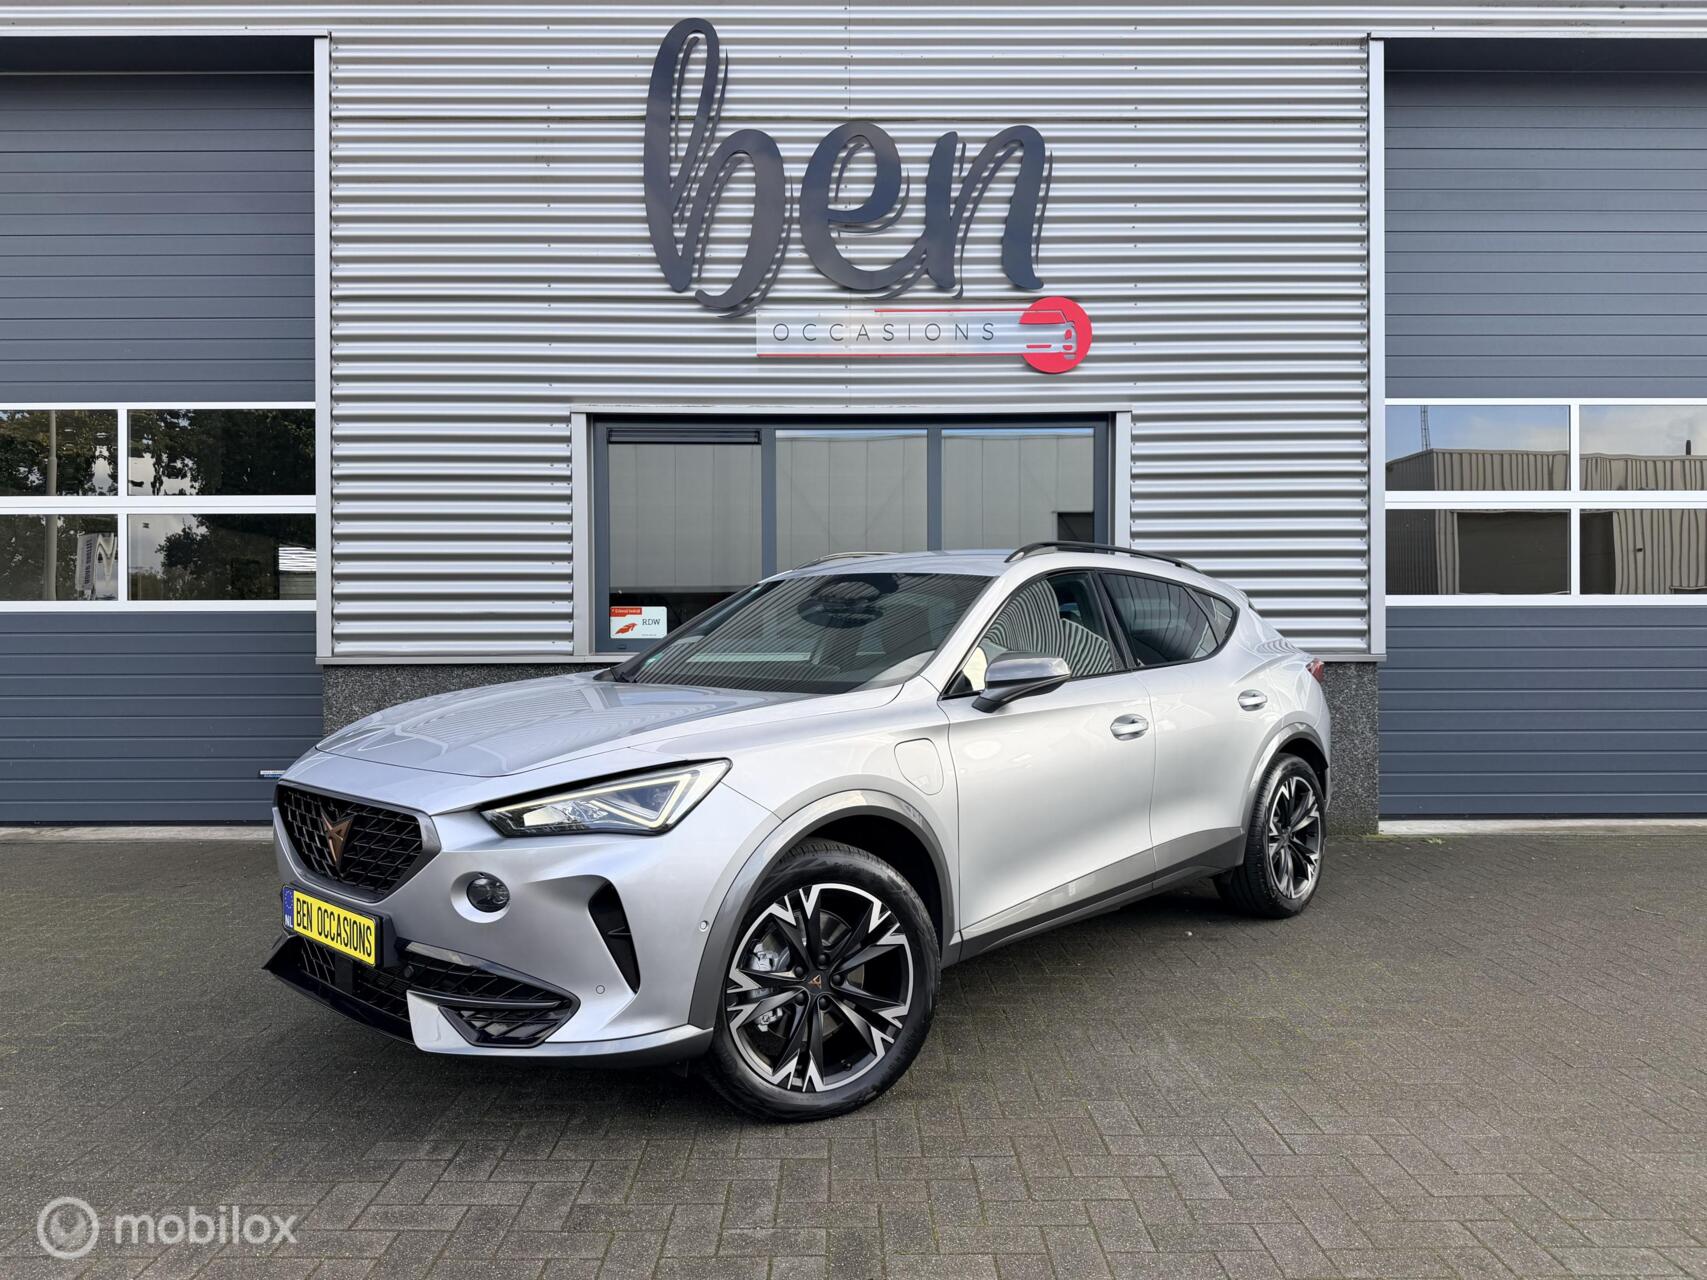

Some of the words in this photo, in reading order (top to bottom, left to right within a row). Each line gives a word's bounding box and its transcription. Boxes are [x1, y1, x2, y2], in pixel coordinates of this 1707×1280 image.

[644, 17, 1046, 309] ben
[772, 323, 994, 342] OCCASIONS
[642, 618, 661, 626] RDW
[285, 914, 293, 928] NL
[296, 898, 313, 933] BEN
[317, 906, 372, 957] OCCASIONS
